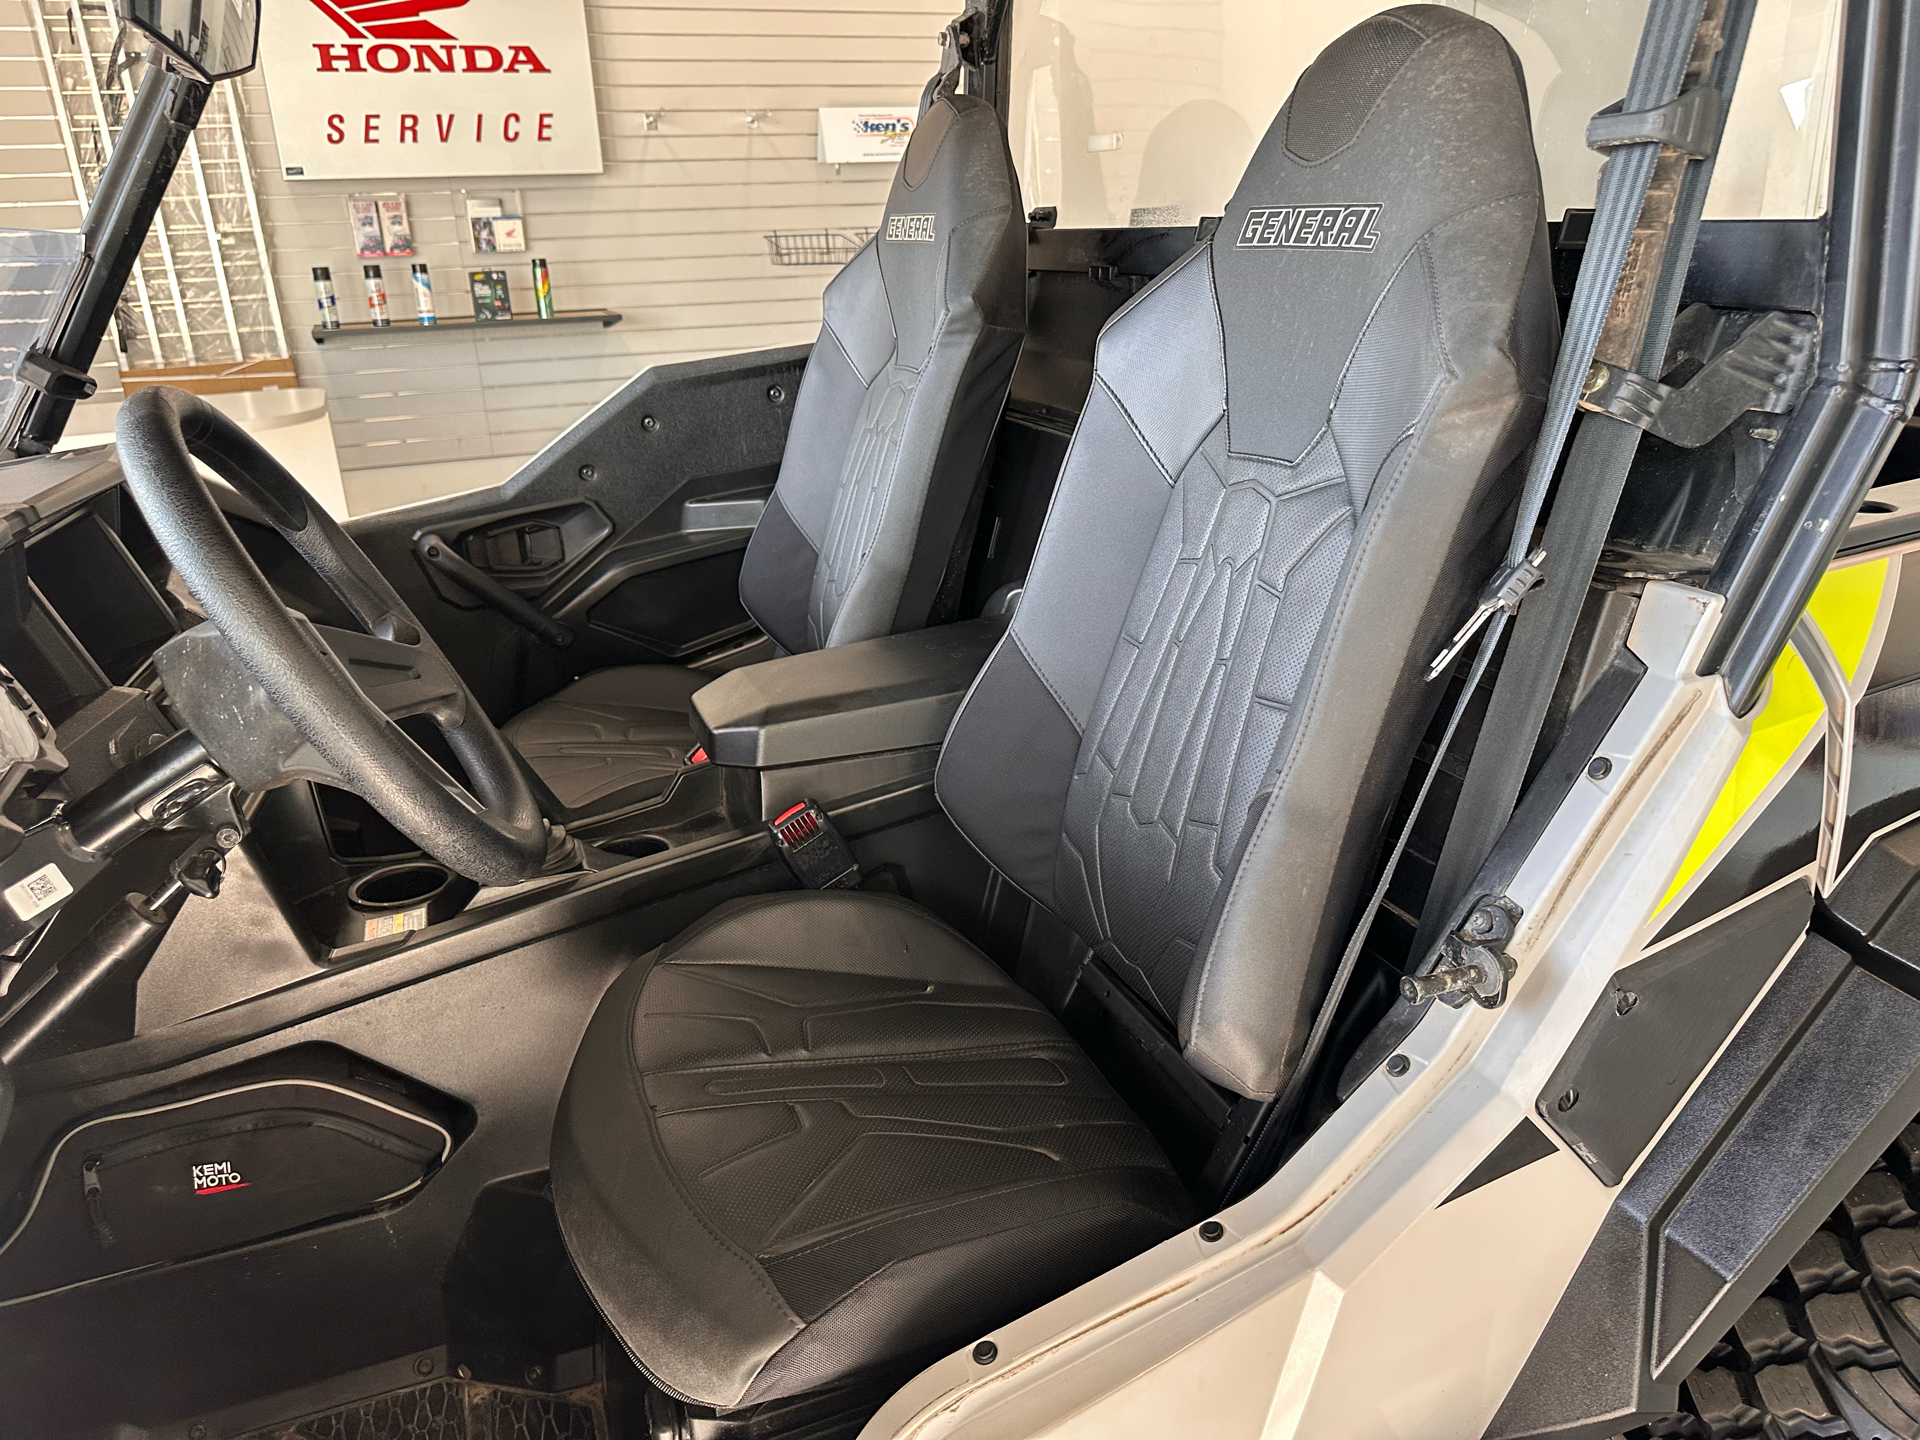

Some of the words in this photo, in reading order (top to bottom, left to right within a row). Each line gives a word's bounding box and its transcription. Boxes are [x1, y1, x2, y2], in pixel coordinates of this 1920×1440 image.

[312, 43, 552, 74] HONDA
[327, 113, 554, 145] SERVICE
[886, 215, 935, 241] GENERAL
[1235, 206, 1380, 249] GENERAL
[192, 1161, 231, 1177] KEMI
[193, 1172, 241, 1189] MOTO
